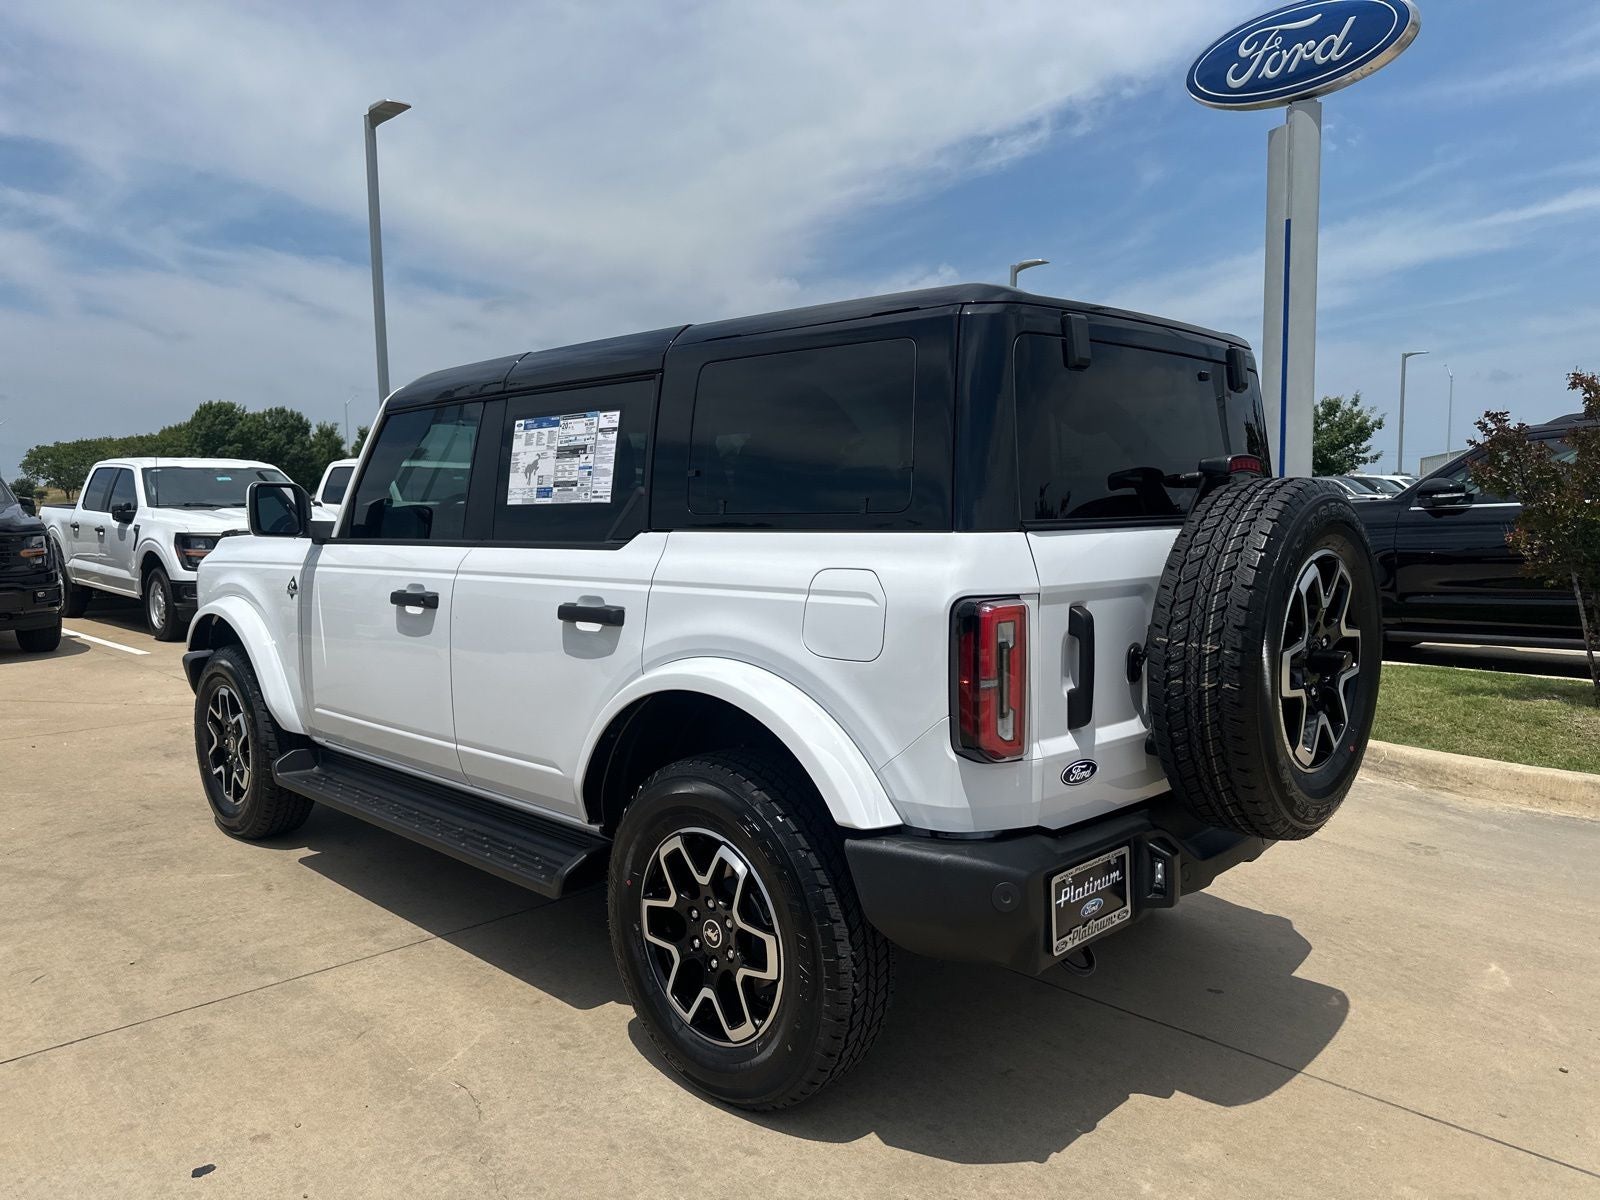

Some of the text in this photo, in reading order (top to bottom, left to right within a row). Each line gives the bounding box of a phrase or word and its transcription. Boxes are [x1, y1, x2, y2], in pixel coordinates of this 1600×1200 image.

[1226, 13, 1356, 88] Ford
[1070, 764, 1093, 782] Ford
[1056, 870, 1123, 908] Platinum
